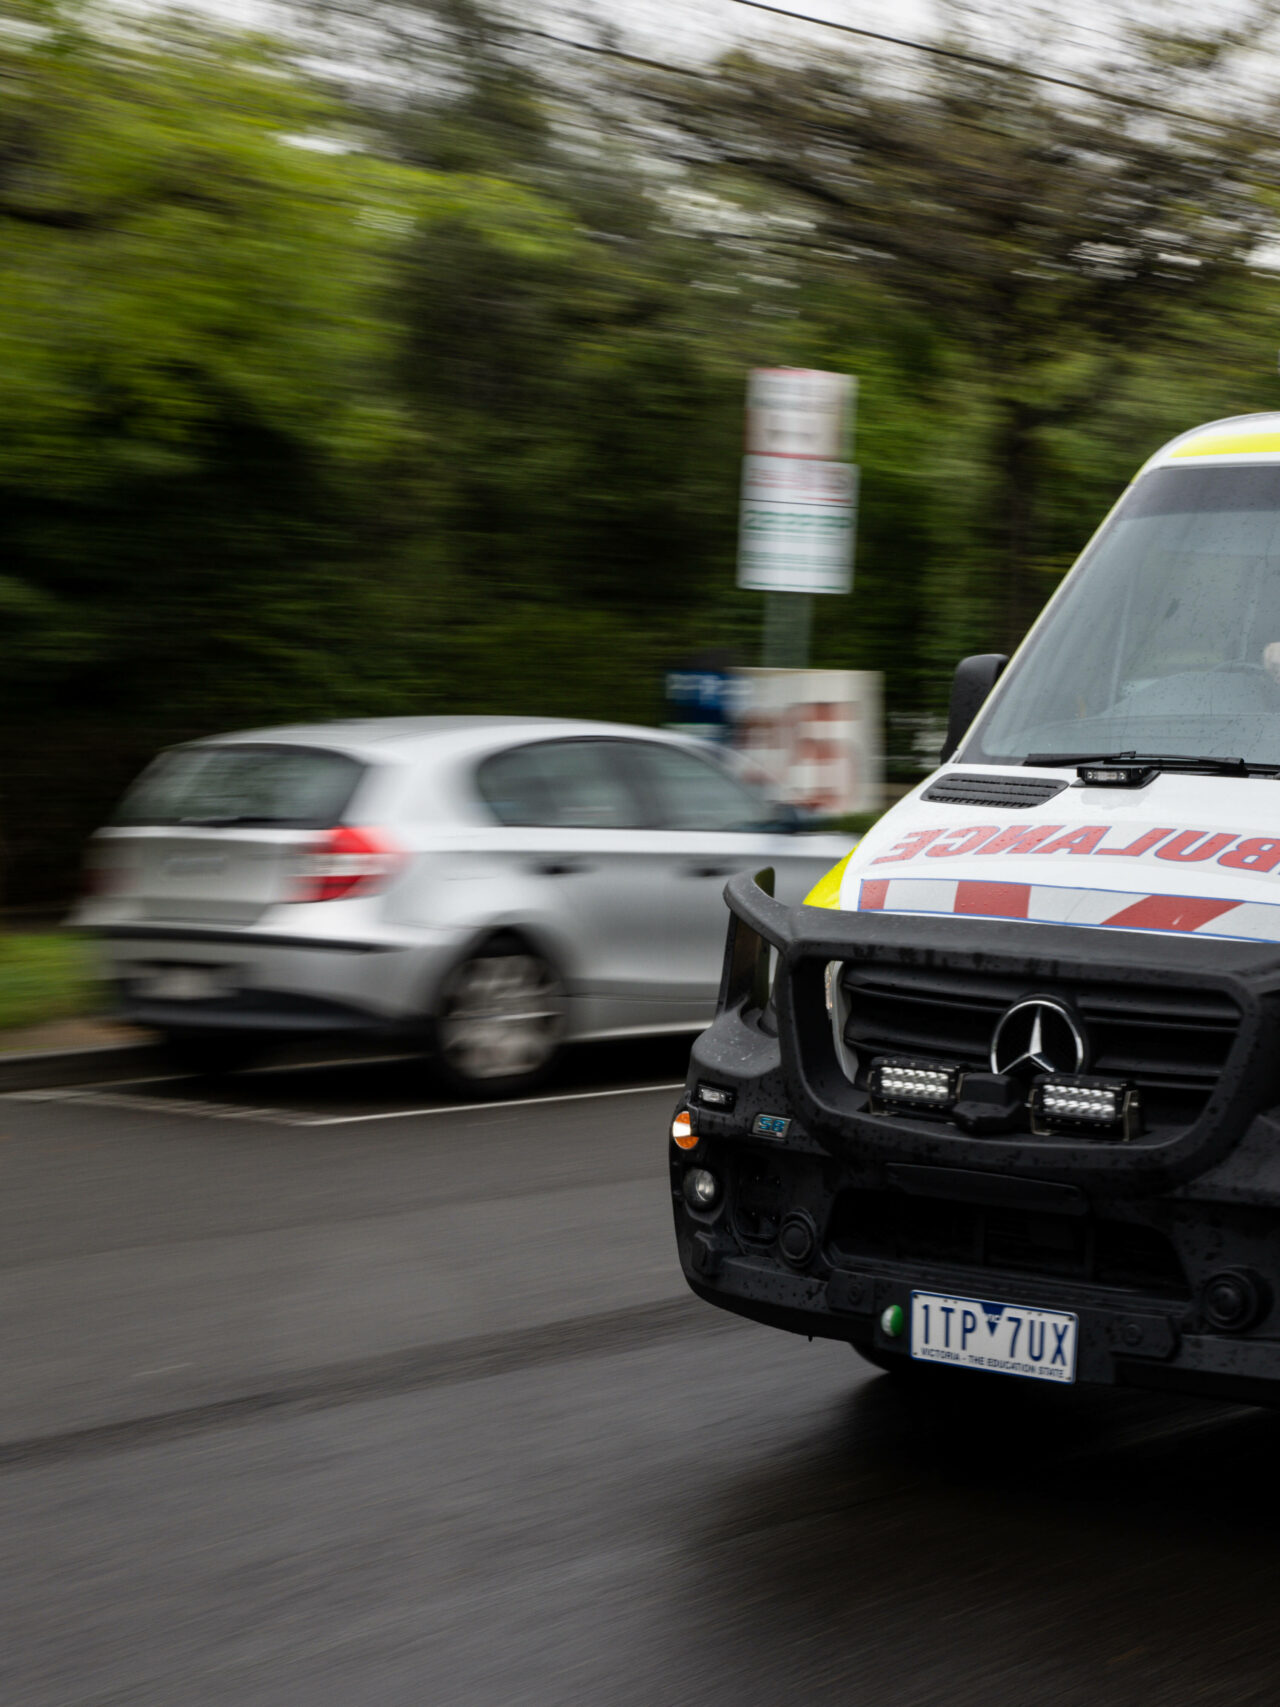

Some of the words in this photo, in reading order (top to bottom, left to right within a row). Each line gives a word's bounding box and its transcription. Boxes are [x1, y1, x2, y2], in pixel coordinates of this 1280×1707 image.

[922, 1304, 977, 1350] 1TP
[1007, 1316, 1069, 1366] 7UX
[921, 1347, 960, 1362] VICTORIA
[968, 1354, 985, 1366] THE
[987, 1357, 1036, 1375] EDUCATION
[1038, 1365, 1065, 1379] STATE
